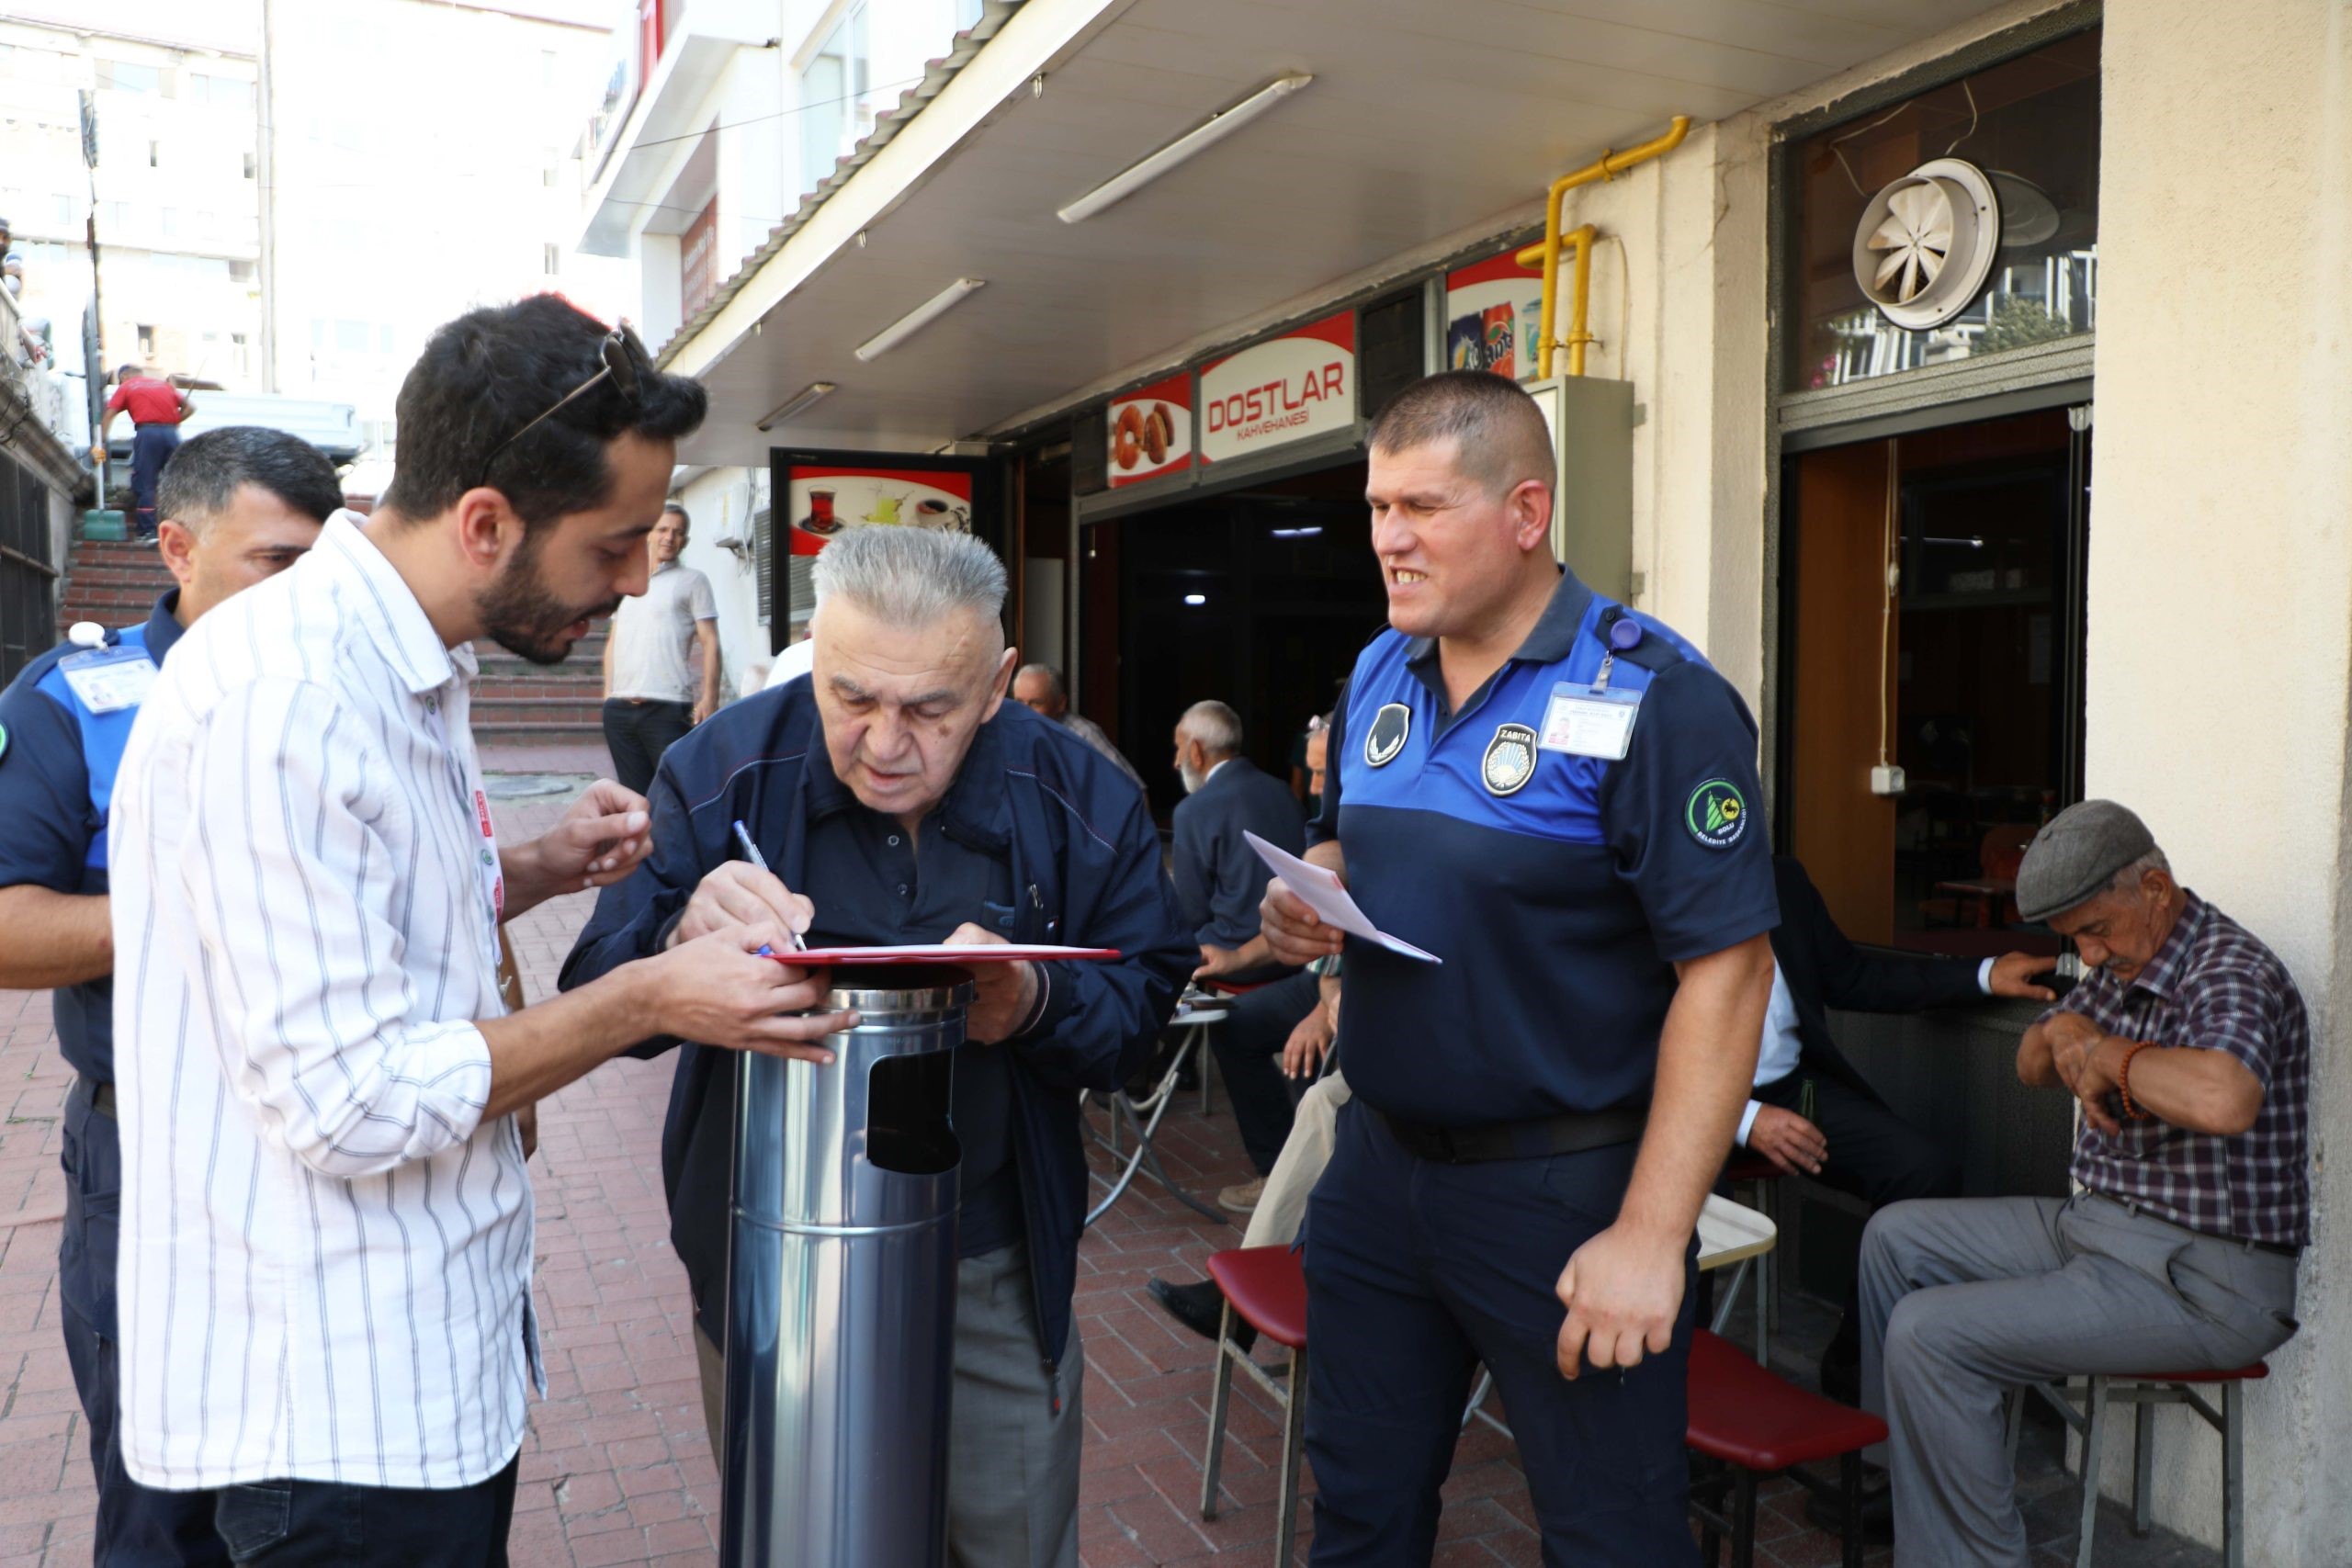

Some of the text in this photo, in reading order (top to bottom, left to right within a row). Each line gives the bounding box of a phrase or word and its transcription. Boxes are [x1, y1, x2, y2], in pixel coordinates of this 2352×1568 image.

[1208, 361, 1344, 434] DOSTLAR
[1499, 729, 1531, 743] ZABITA
[1717, 822, 1735, 835] BOLU
[1696, 830, 1726, 845] BELEDİYE
